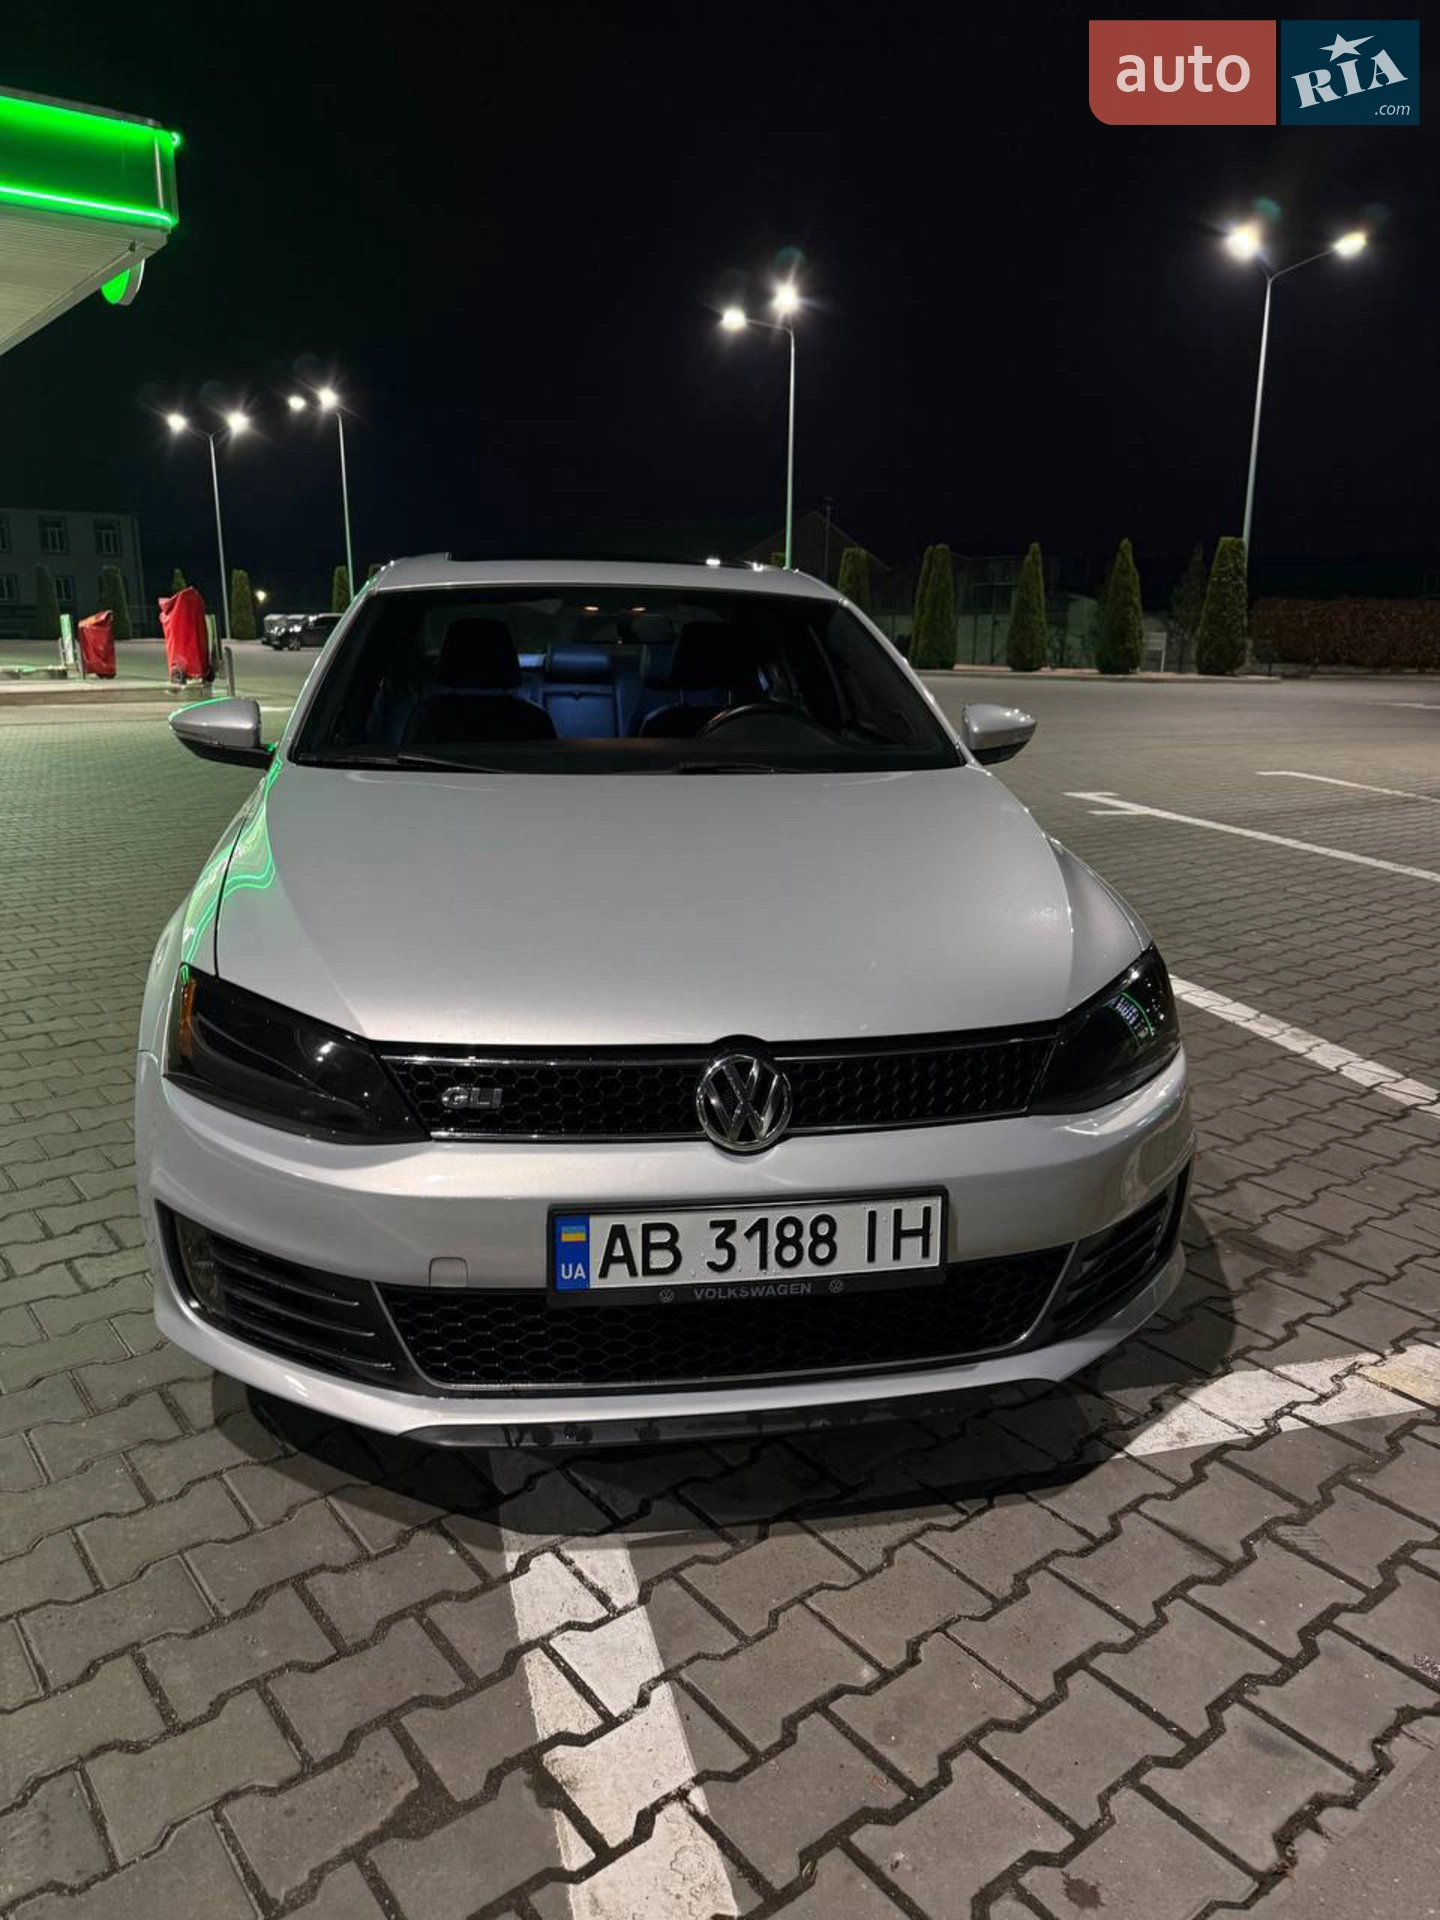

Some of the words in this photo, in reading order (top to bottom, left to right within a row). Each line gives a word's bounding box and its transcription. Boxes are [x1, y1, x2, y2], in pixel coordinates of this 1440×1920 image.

[441, 1086, 502, 1109] GLI
[598, 1222, 683, 1279] AB
[706, 1213, 838, 1273] 3188
[866, 1205, 932, 1263] IH
[561, 1264, 587, 1280] UA
[693, 1282, 812, 1300] VOLKSWAGEN
